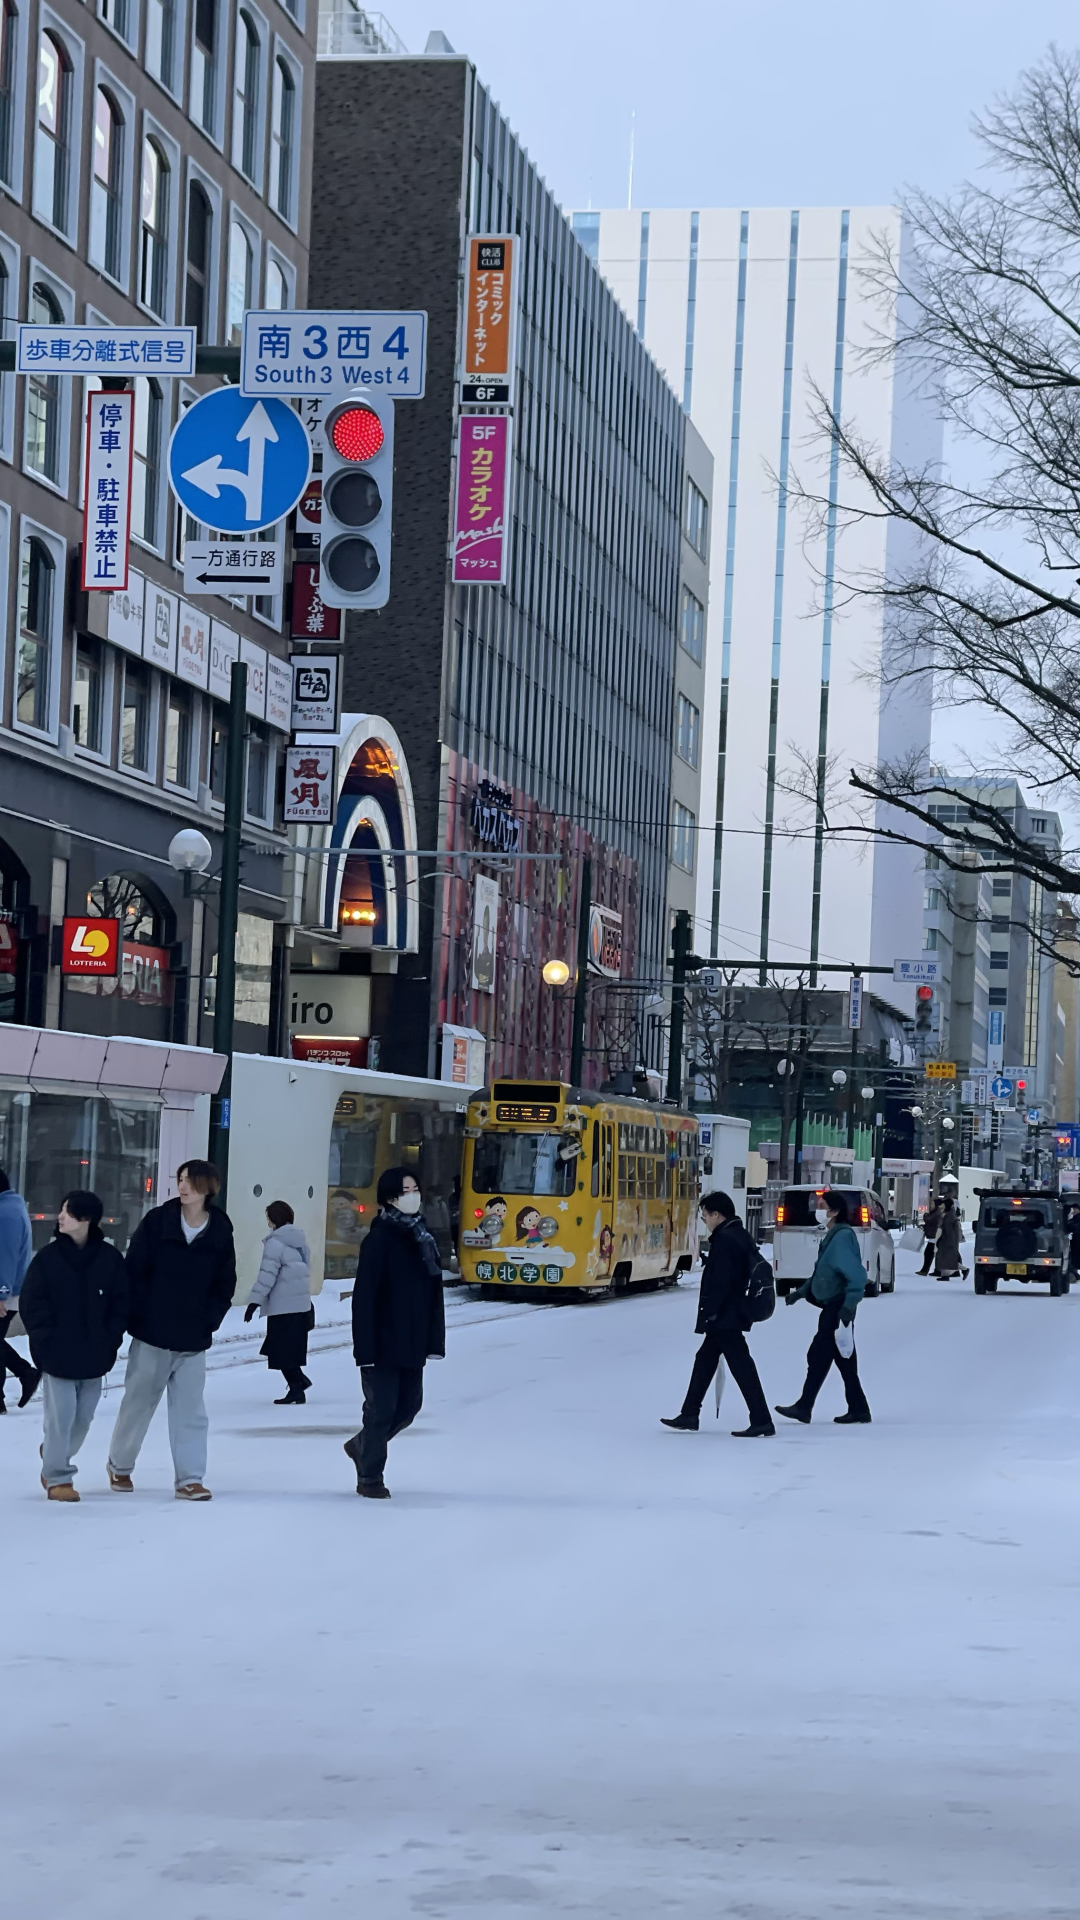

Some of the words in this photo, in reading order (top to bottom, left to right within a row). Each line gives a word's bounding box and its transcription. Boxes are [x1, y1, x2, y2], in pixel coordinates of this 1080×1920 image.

[481, 258, 501, 266] CLUB
[489, 272, 504, 326] コミック
[473, 272, 489, 367] インターネット
[26, 338, 186, 364] 歩車分離式信号
[476, 386, 496, 400] 6F
[472, 425, 496, 440] 5F
[469, 447, 494, 521] カラオケ
[191, 549, 276, 568] 一方通行路
[460, 558, 498, 568] マッシュ
[306, 567, 325, 634] しぶ葉
[477, 1262, 561, 1283] 幌北学園
